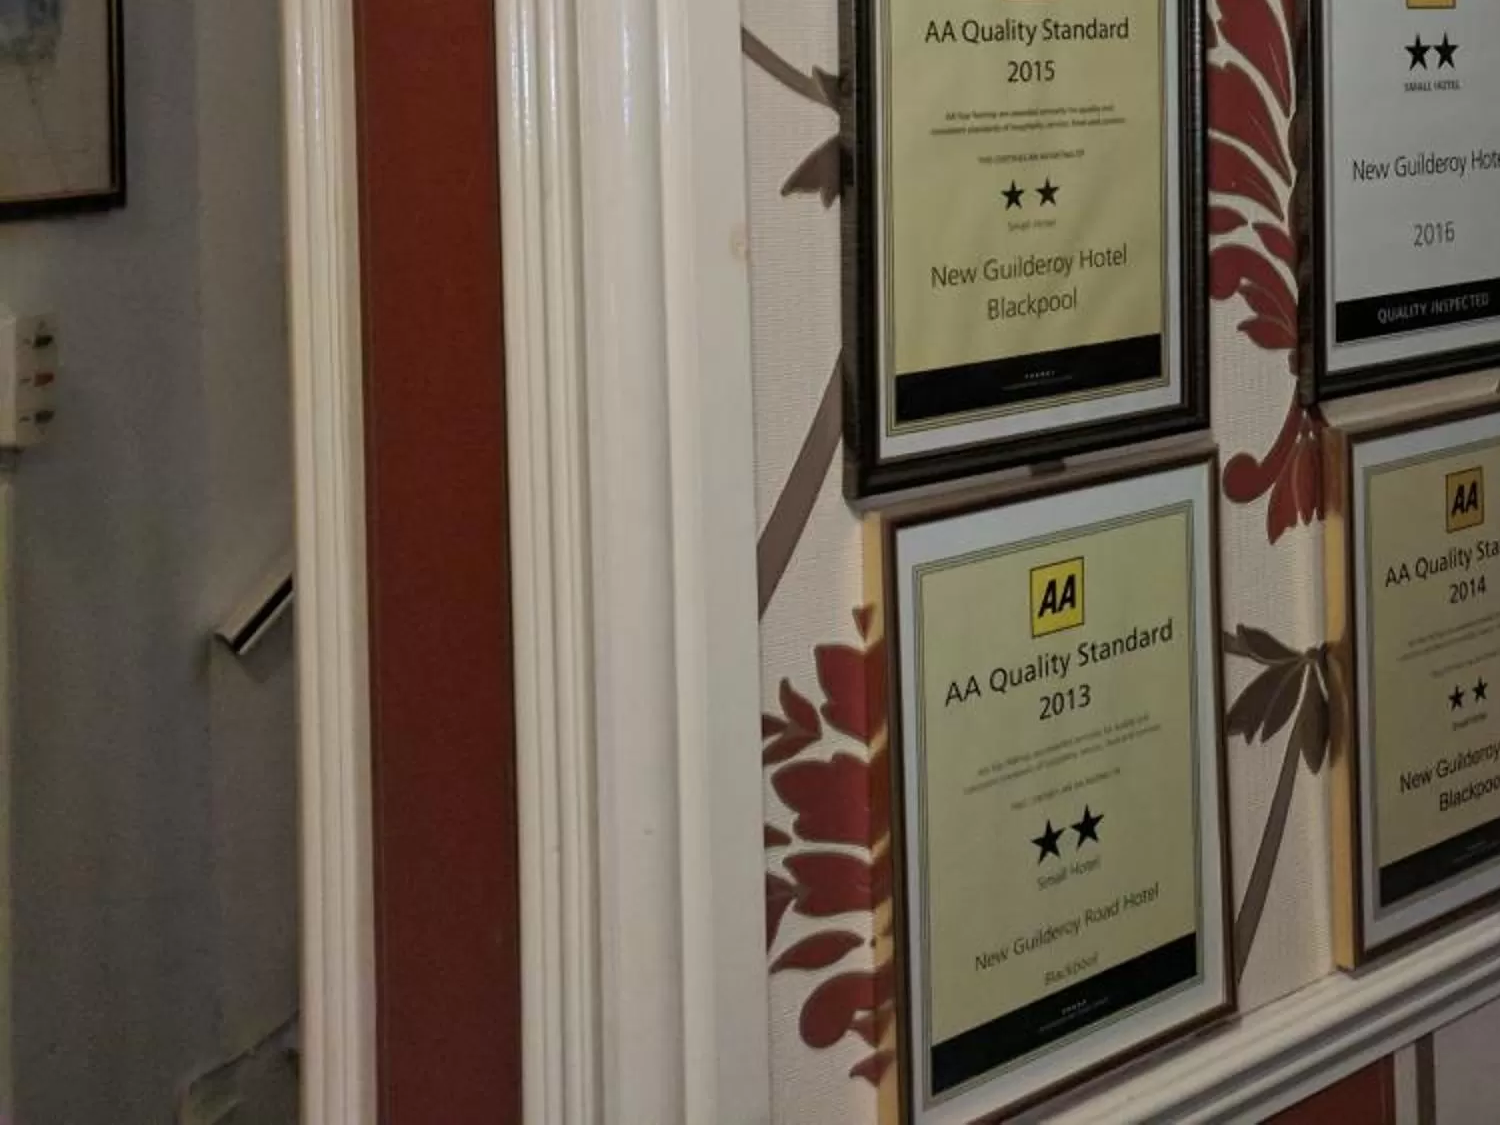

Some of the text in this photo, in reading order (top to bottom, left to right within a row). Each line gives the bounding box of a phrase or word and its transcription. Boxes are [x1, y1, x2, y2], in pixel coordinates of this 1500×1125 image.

[924, 17, 1130, 46] AA Quality Standard
[1007, 60, 1055, 83] 2015
[1353, 159, 1390, 181] New
[1394, 153, 1467, 178] Guilderoy
[1413, 221, 1456, 248] 2016
[931, 243, 1128, 288] New Guilderoy Hotel
[987, 287, 1078, 320] Blackpool
[1377, 292, 1489, 324] QUALITY INSPECTED
[1451, 480, 1479, 516] AA
[1385, 563, 1410, 588] AA
[1415, 546, 1473, 579] Quality
[1037, 574, 1076, 619] AA
[1450, 575, 1487, 604] 2014
[945, 618, 1174, 707] AA Quality Standard
[1039, 683, 1091, 721] 2013
[1400, 772, 1432, 794] New
[1435, 741, 1500, 779] Guilderoy
[975, 882, 1160, 972] New Guilderoy Road Hotel
